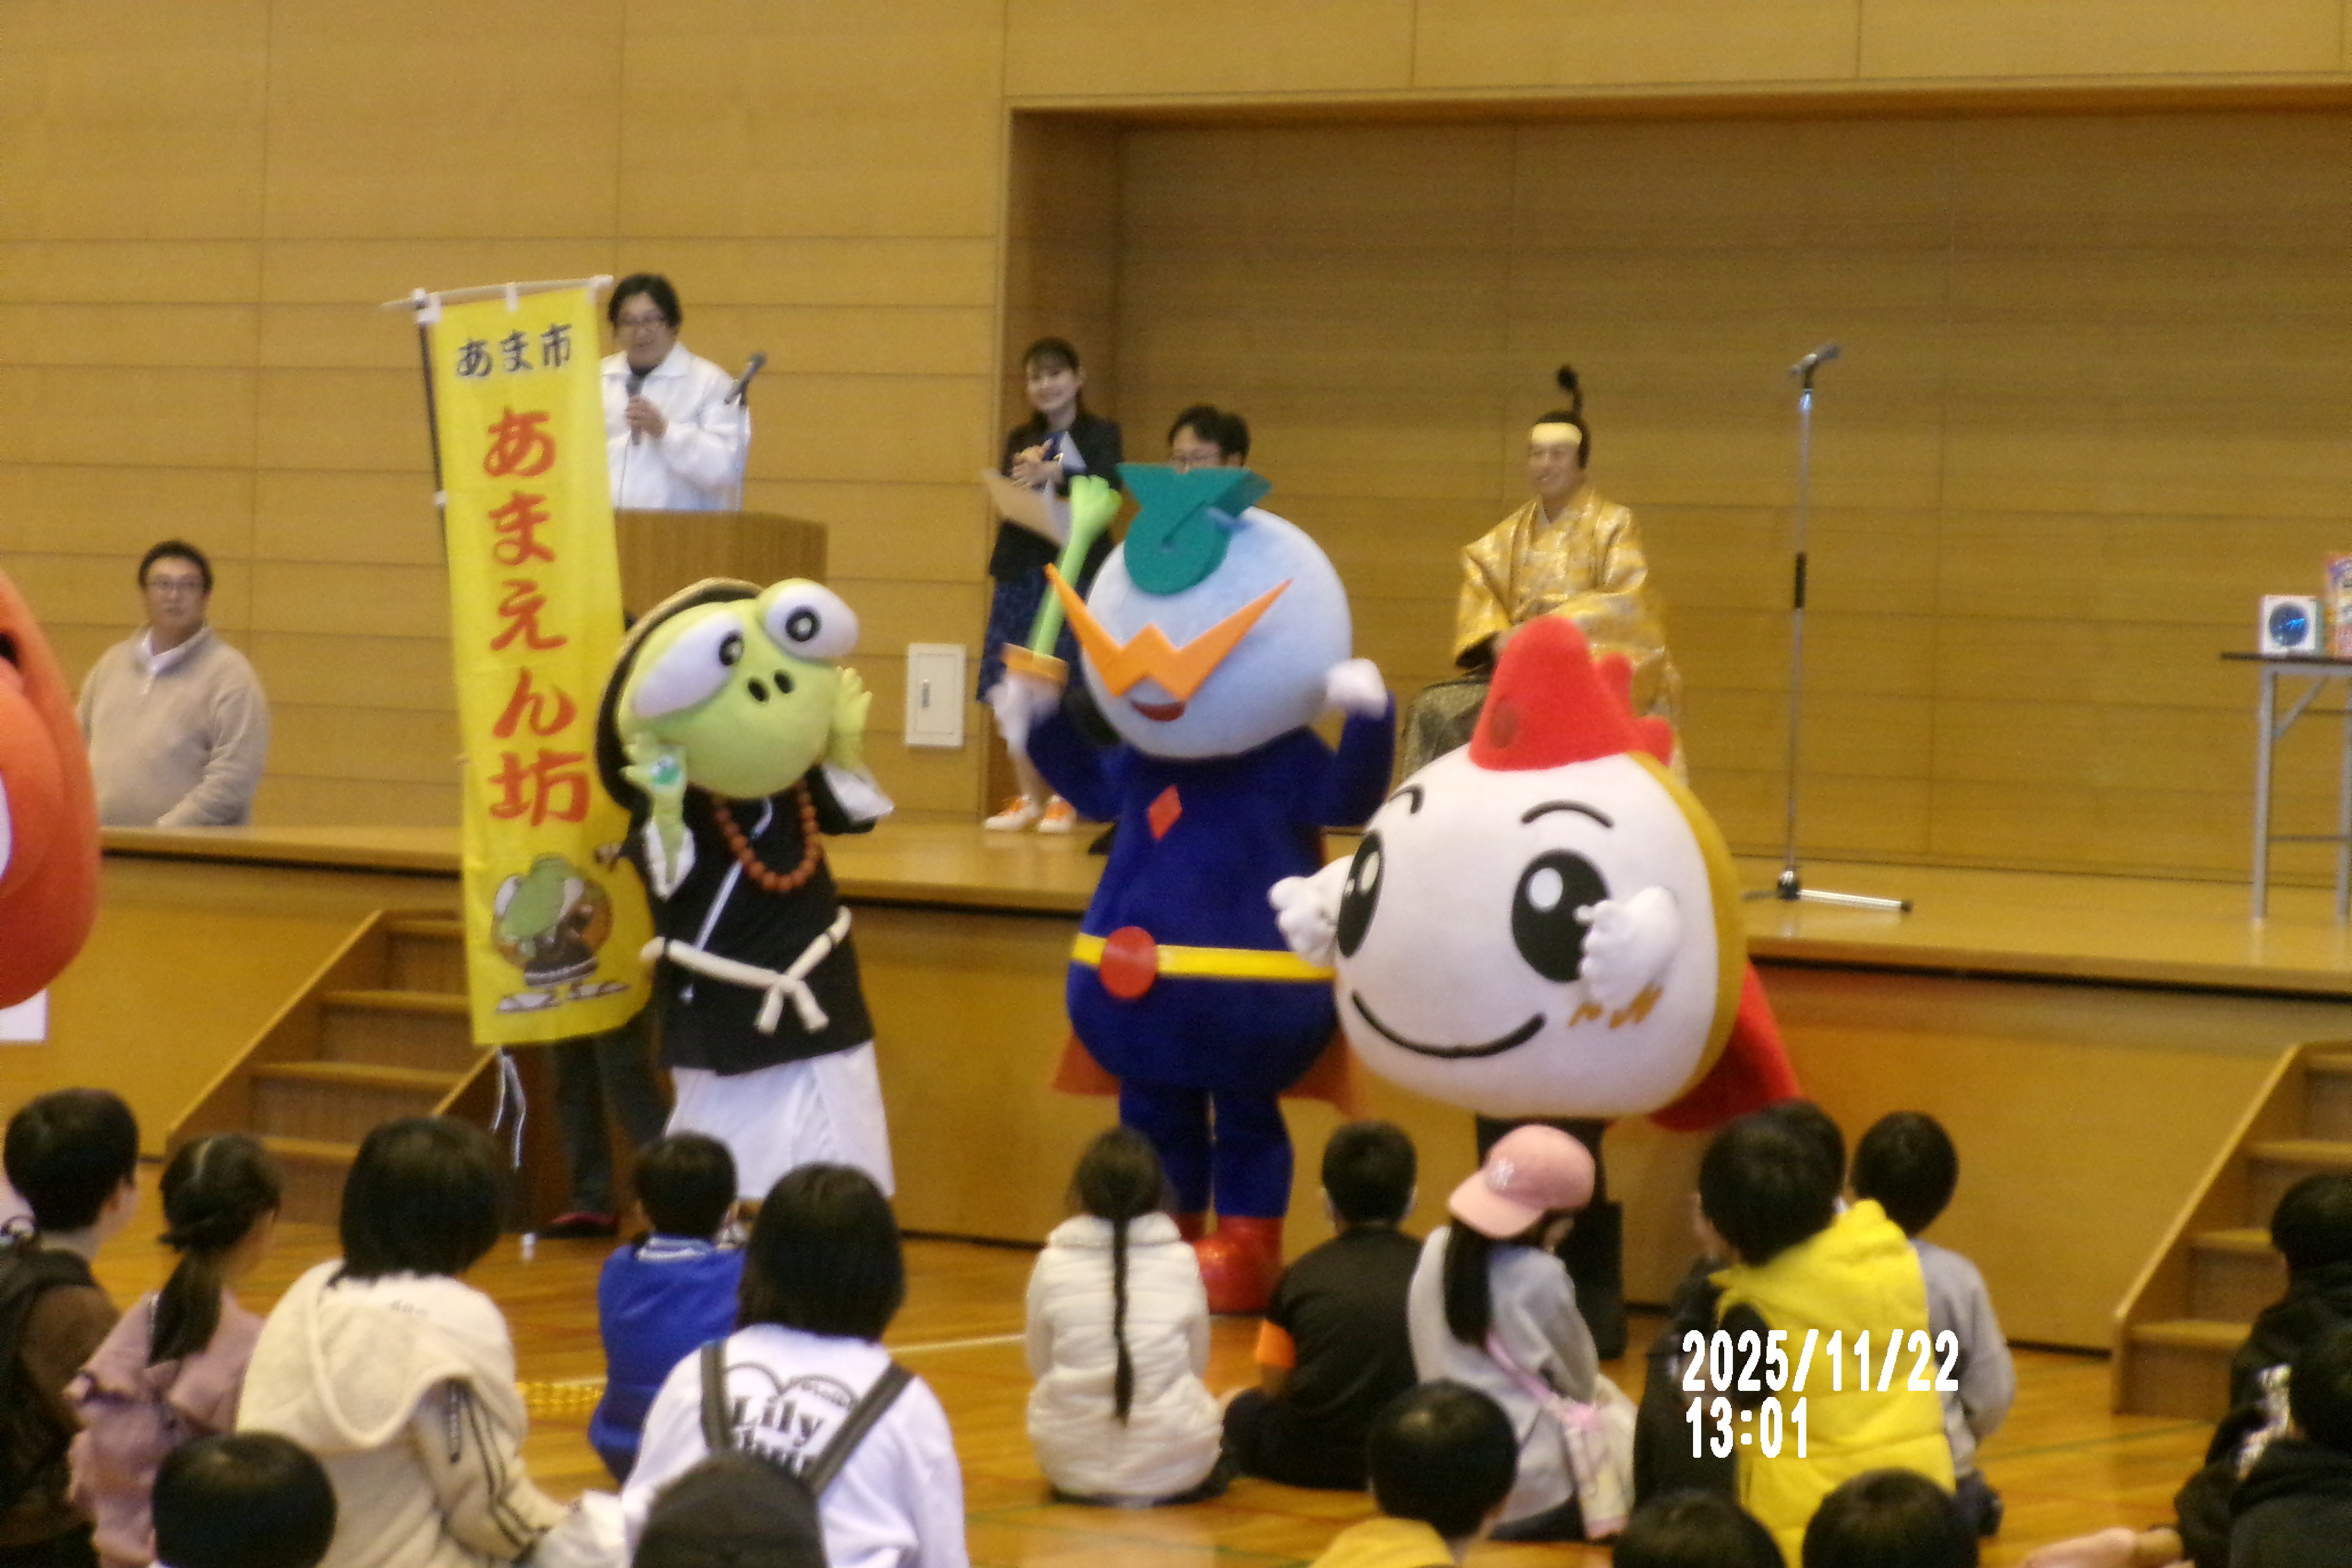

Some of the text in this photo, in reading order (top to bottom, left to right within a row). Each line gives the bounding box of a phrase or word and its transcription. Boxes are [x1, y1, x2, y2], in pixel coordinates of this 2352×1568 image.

[455, 323, 574, 378] あま市
[483, 408, 592, 827] あまえん坊
